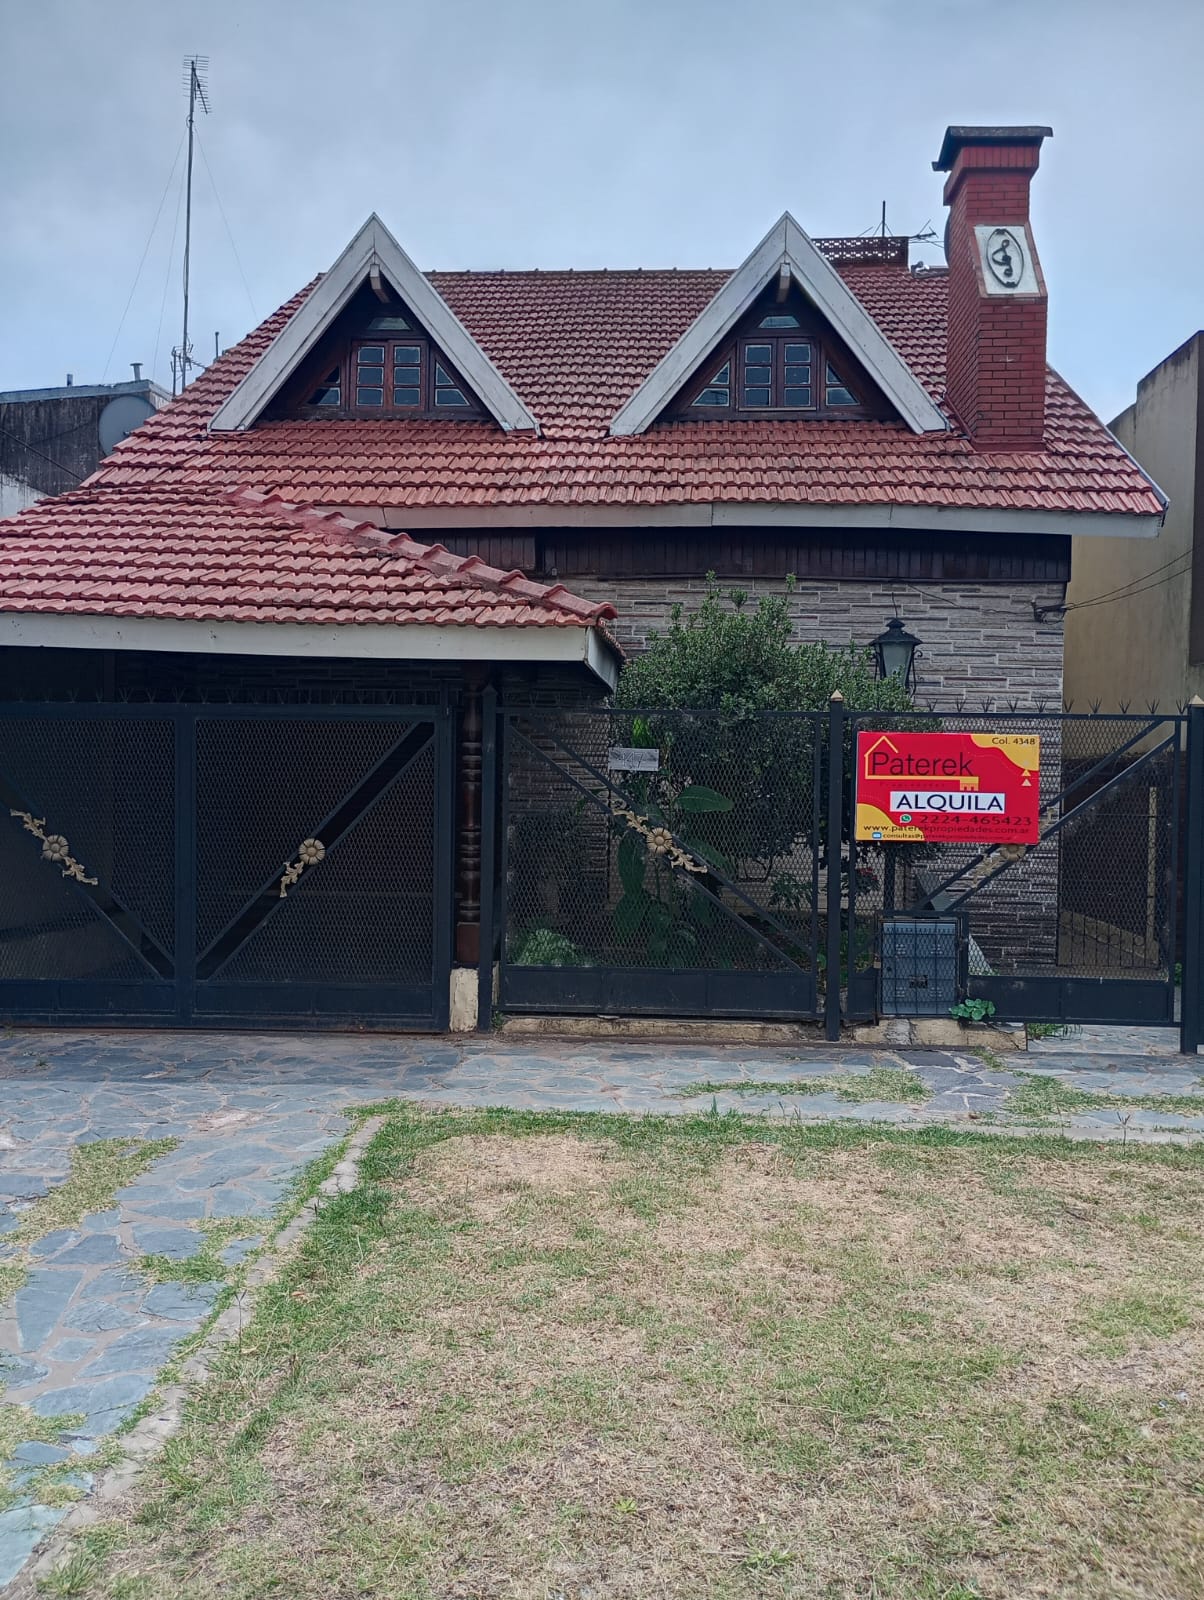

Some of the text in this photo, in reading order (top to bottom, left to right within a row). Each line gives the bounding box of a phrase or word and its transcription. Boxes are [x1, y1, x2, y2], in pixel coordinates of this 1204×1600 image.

[991, 736, 1036, 745] Col. 4348
[871, 751, 975, 776] Paterek
[896, 793, 1004, 812] ALQUILA
[919, 814, 1033, 826] 2224-465423
